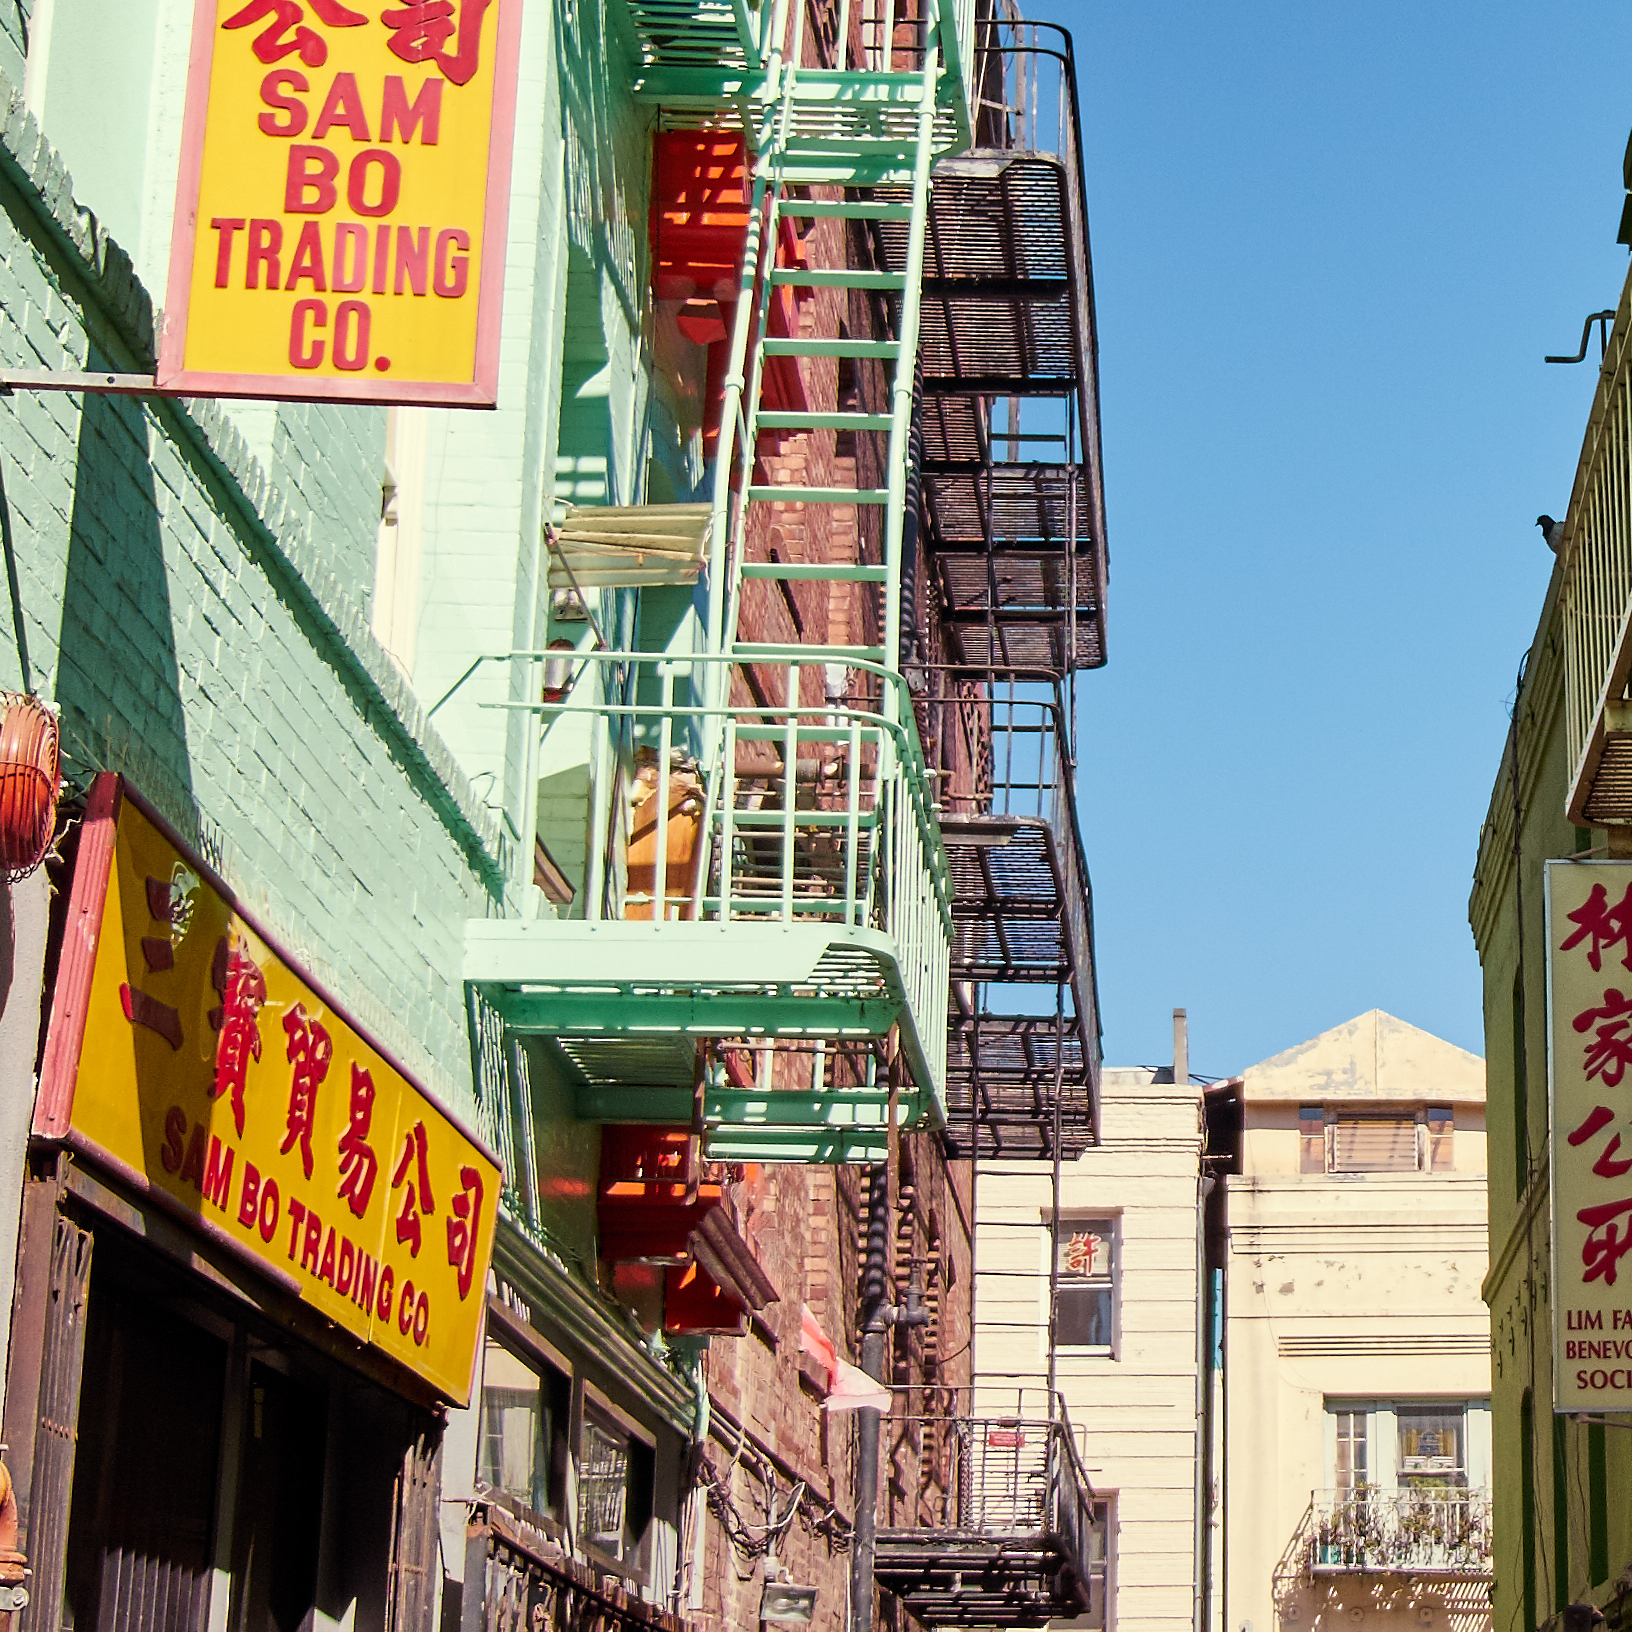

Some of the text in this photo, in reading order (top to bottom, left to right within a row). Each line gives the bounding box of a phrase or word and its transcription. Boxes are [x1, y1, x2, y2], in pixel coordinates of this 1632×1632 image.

[259, 69, 444, 146] SAM
[284, 145, 401, 218] BO
[211, 218, 470, 299] TRADING
[289, 298, 391, 371] CO.
[161, 1108, 430, 1347] SAM BO TRADING CO.
[1567, 1309, 1604, 1333] LIM
